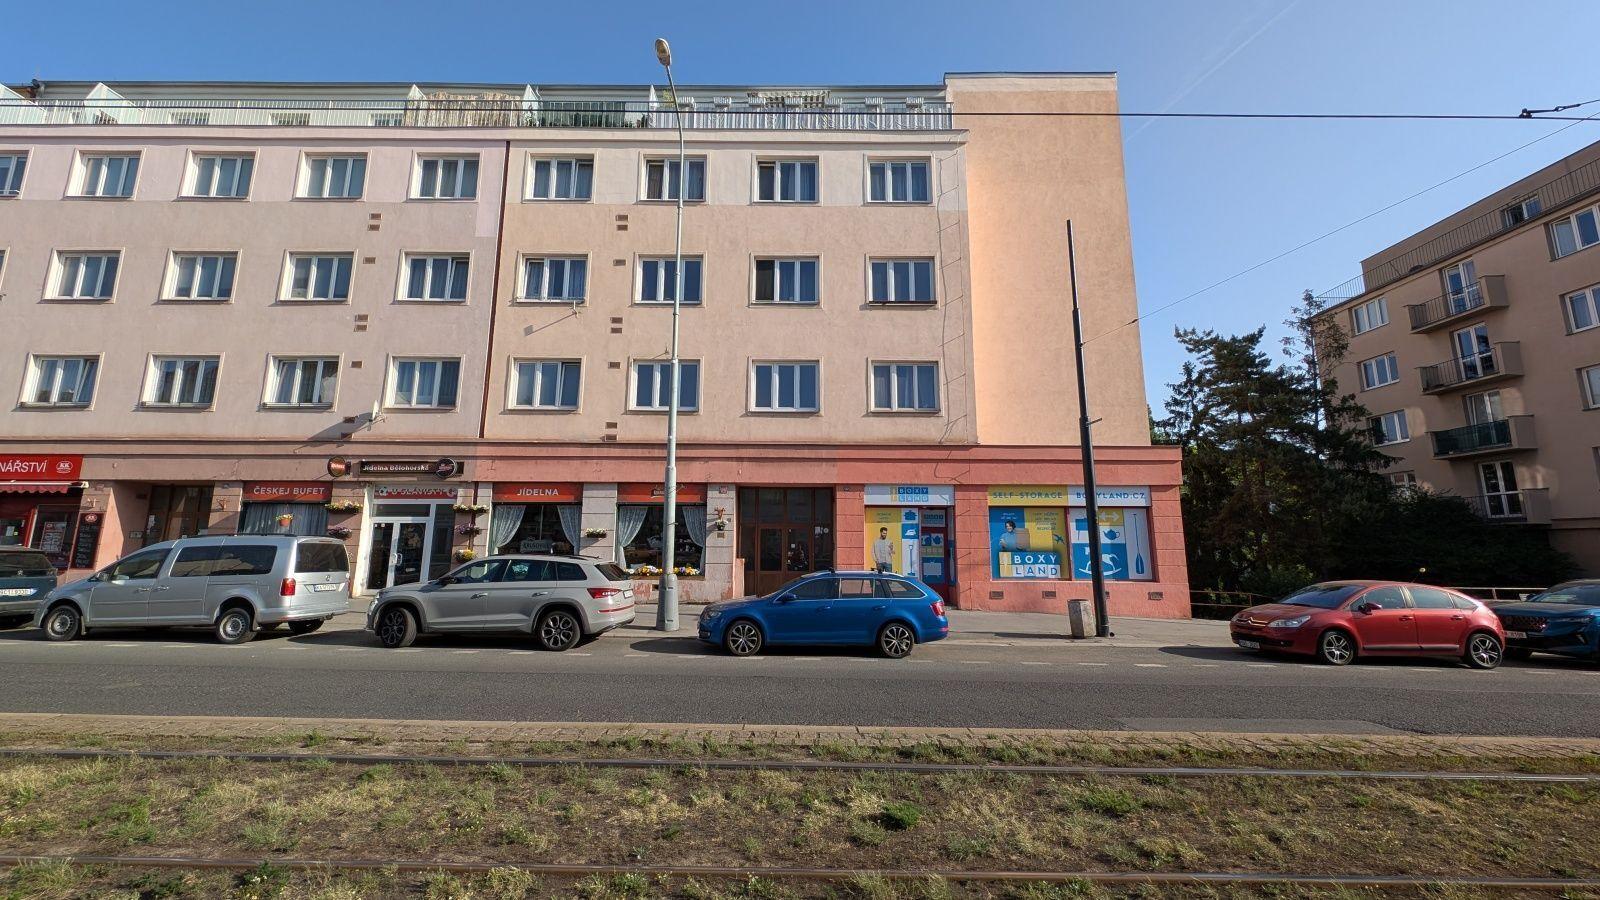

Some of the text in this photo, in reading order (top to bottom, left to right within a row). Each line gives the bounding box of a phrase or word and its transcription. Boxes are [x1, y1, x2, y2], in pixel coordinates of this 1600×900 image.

[253, 485, 325, 495] ČESKEJ BUFET
[516, 487, 559, 496] JÍDELNA
[992, 491, 1063, 499] SELF-STORAGE
[1013, 554, 1057, 564] BOXY
[1015, 566, 1058, 576] LAND
